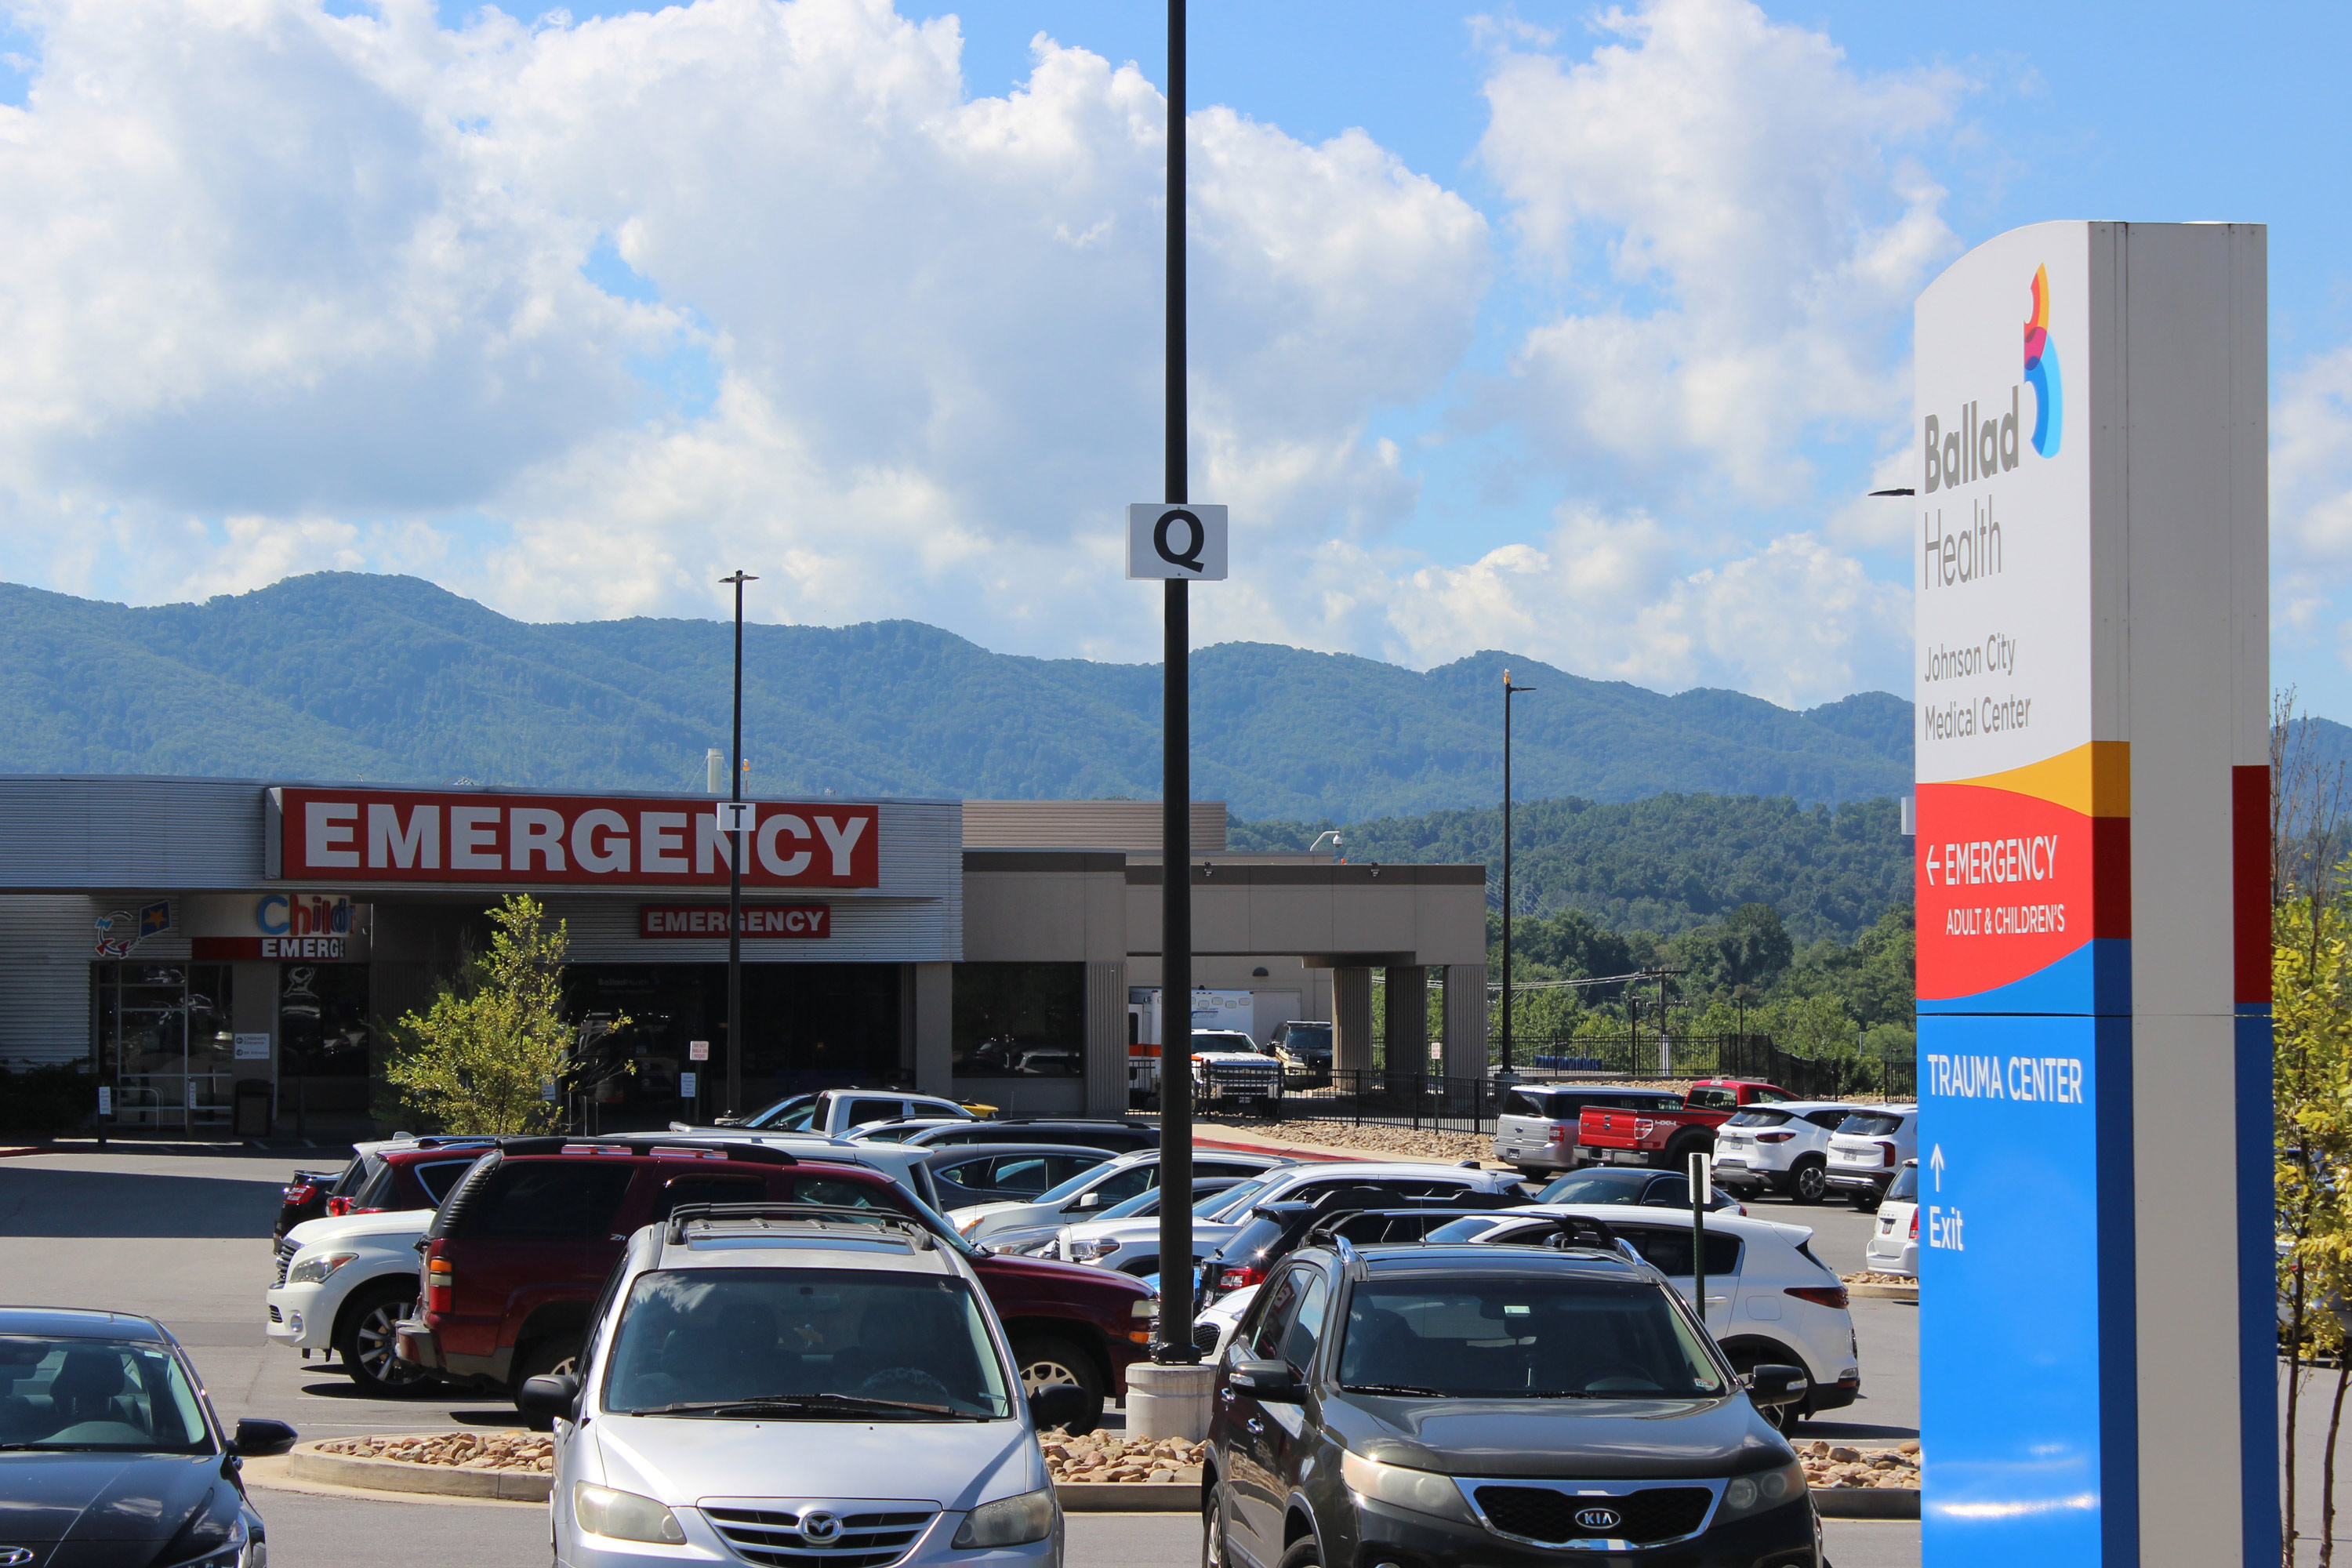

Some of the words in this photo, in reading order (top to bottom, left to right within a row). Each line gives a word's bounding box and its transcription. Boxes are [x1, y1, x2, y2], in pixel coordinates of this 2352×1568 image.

[1926, 385, 2019, 495] Ballad
[1153, 509, 1204, 573] Q
[1925, 495, 2002, 590] Health
[1925, 643, 1981, 682] Johnson
[1987, 632, 2016, 676] City
[1925, 699, 1976, 741] Medical
[1981, 694, 2031, 734] Center
[305, 801, 869, 877] EMERGENCY
[728, 804, 747, 829] T
[1945, 834, 2058, 885] EMERGENCY
[258, 895, 355, 936] Childr
[1946, 908, 1982, 935] ADULT
[1984, 907, 1992, 935] &
[1994, 903, 2065, 935] CHILDREN'S
[1927, 1054, 2004, 1099] TRAUMA
[2008, 1057, 2083, 1104] CENTER
[1929, 1205, 1964, 1251] Exit
[1584, 1512, 1613, 1524] KIA
